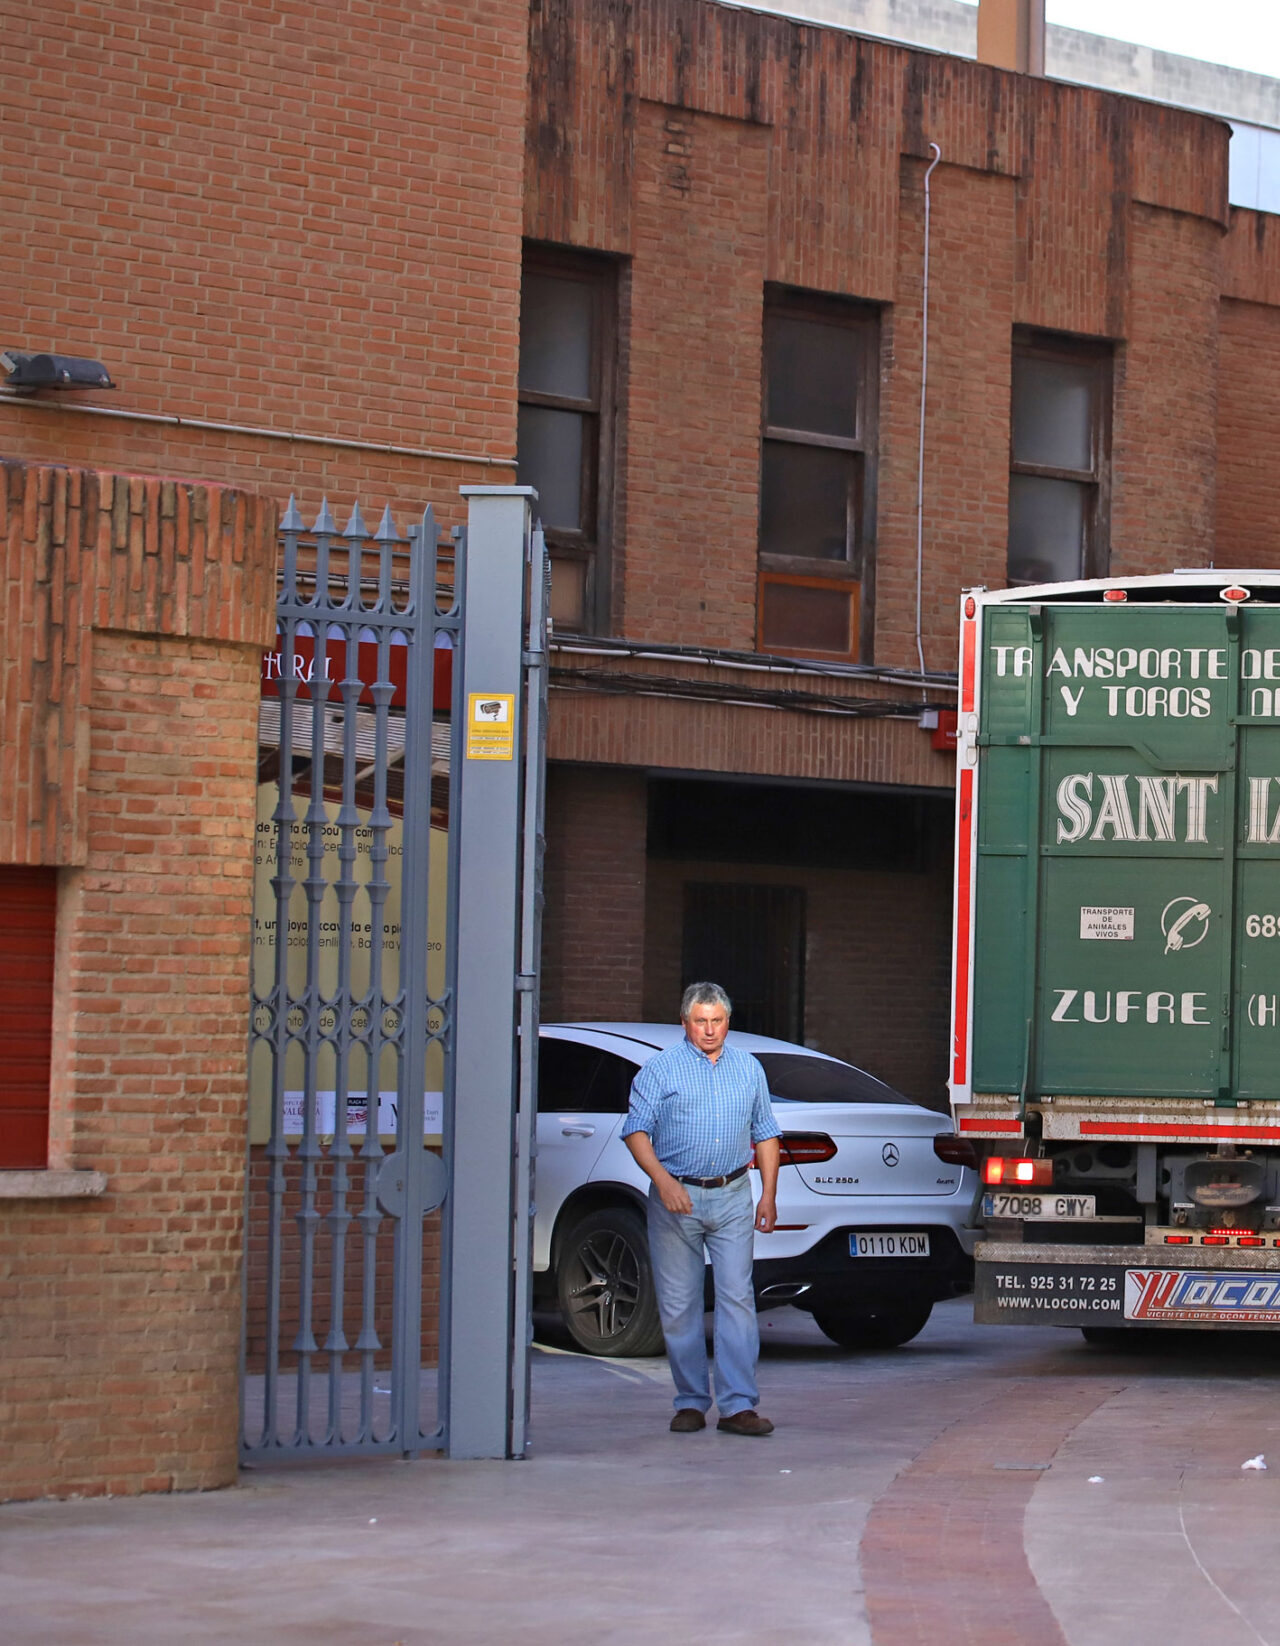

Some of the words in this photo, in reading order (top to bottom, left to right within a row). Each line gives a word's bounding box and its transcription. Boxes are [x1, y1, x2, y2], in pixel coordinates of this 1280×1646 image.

[1060, 686, 1084, 716] Y
[1101, 686, 1211, 717] TOROS
[1051, 989, 1211, 1024] ZUFRE
[999, 1196, 1042, 1216] 7008
[1055, 1198, 1087, 1217] CWY
[859, 1236, 895, 1254] 0110
[900, 1236, 926, 1254] KDM
[996, 1275, 1025, 1289] TEL.
[1030, 1276, 1054, 1289] 925
[1059, 1277, 1074, 1290] 31
[1080, 1278, 1095, 1290] 72
[1100, 1278, 1116, 1291] 25
[997, 1297, 1120, 1311] WWW.VLOCON.COM
